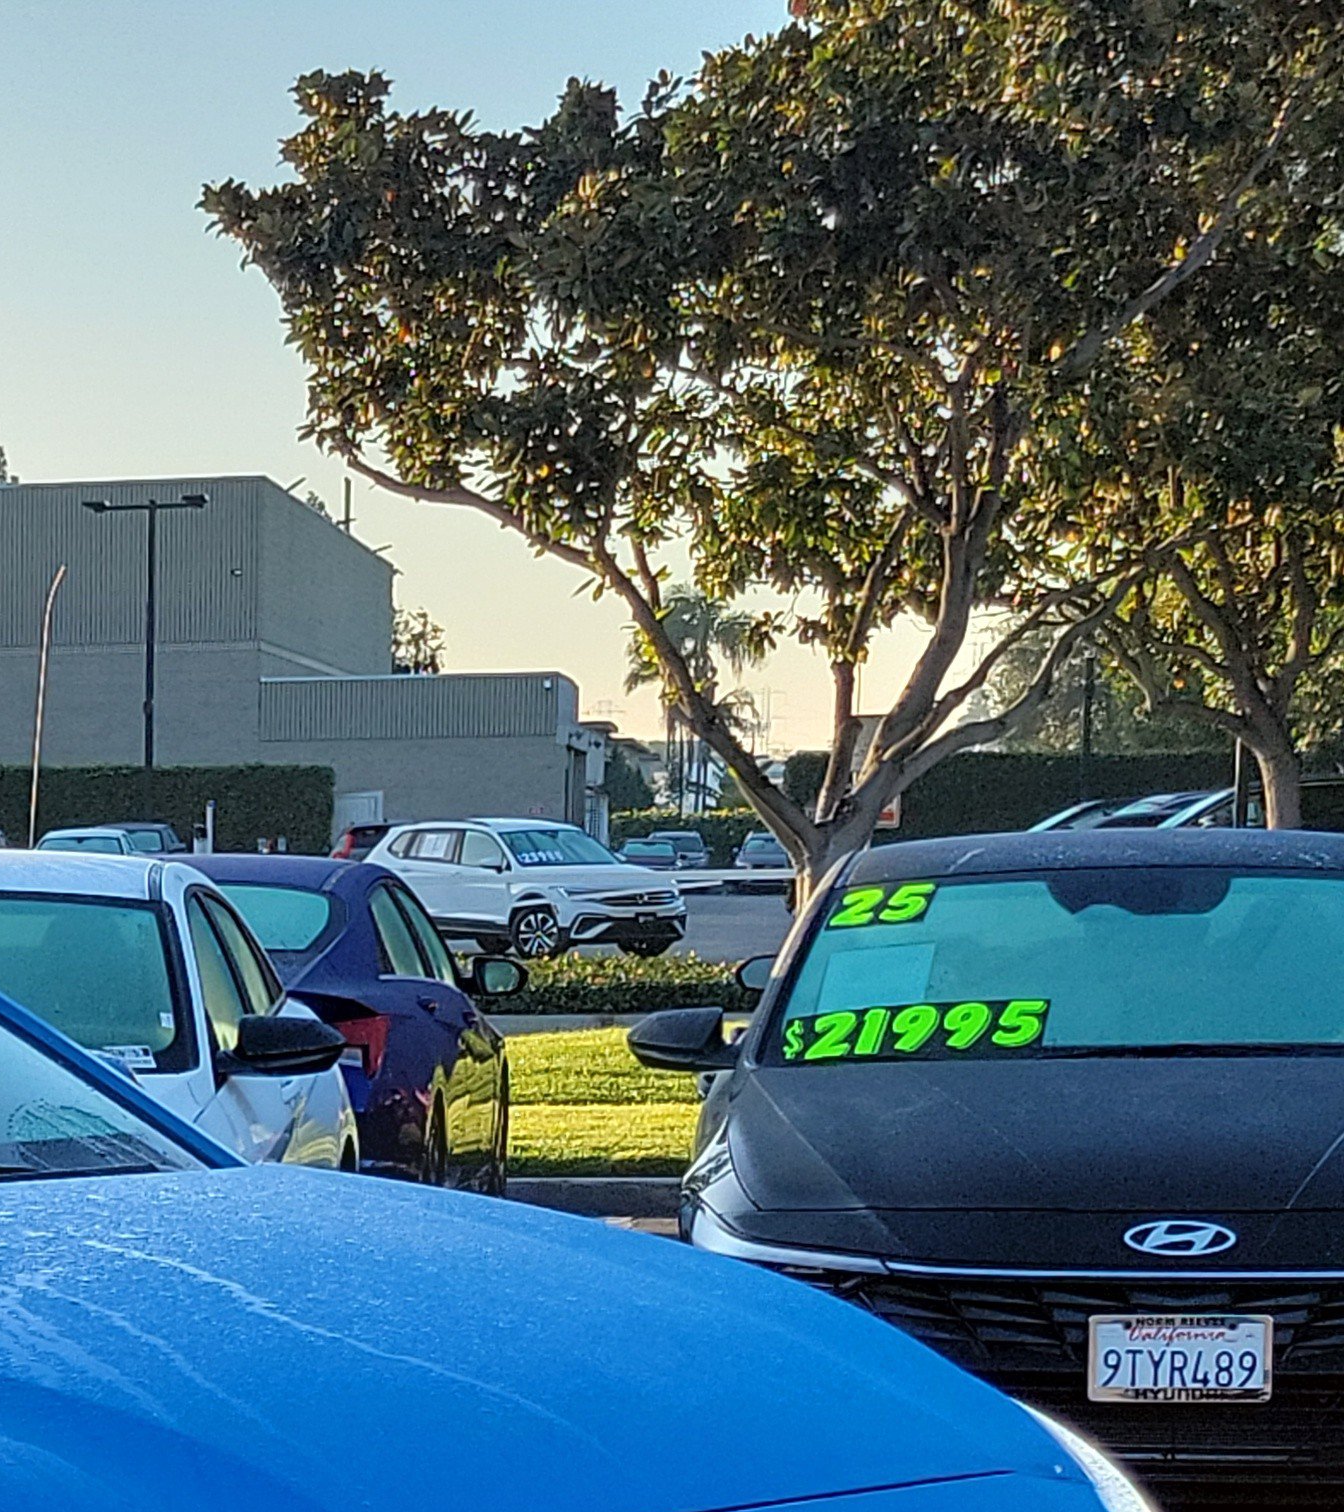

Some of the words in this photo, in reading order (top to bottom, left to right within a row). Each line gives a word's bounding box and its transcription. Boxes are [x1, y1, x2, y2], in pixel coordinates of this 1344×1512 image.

[829, 883, 937, 926] 25
[783, 1000, 1049, 1060] $21995
[1129, 1325, 1227, 1347] California
[1101, 1348, 1257, 1388] 9TYR489
